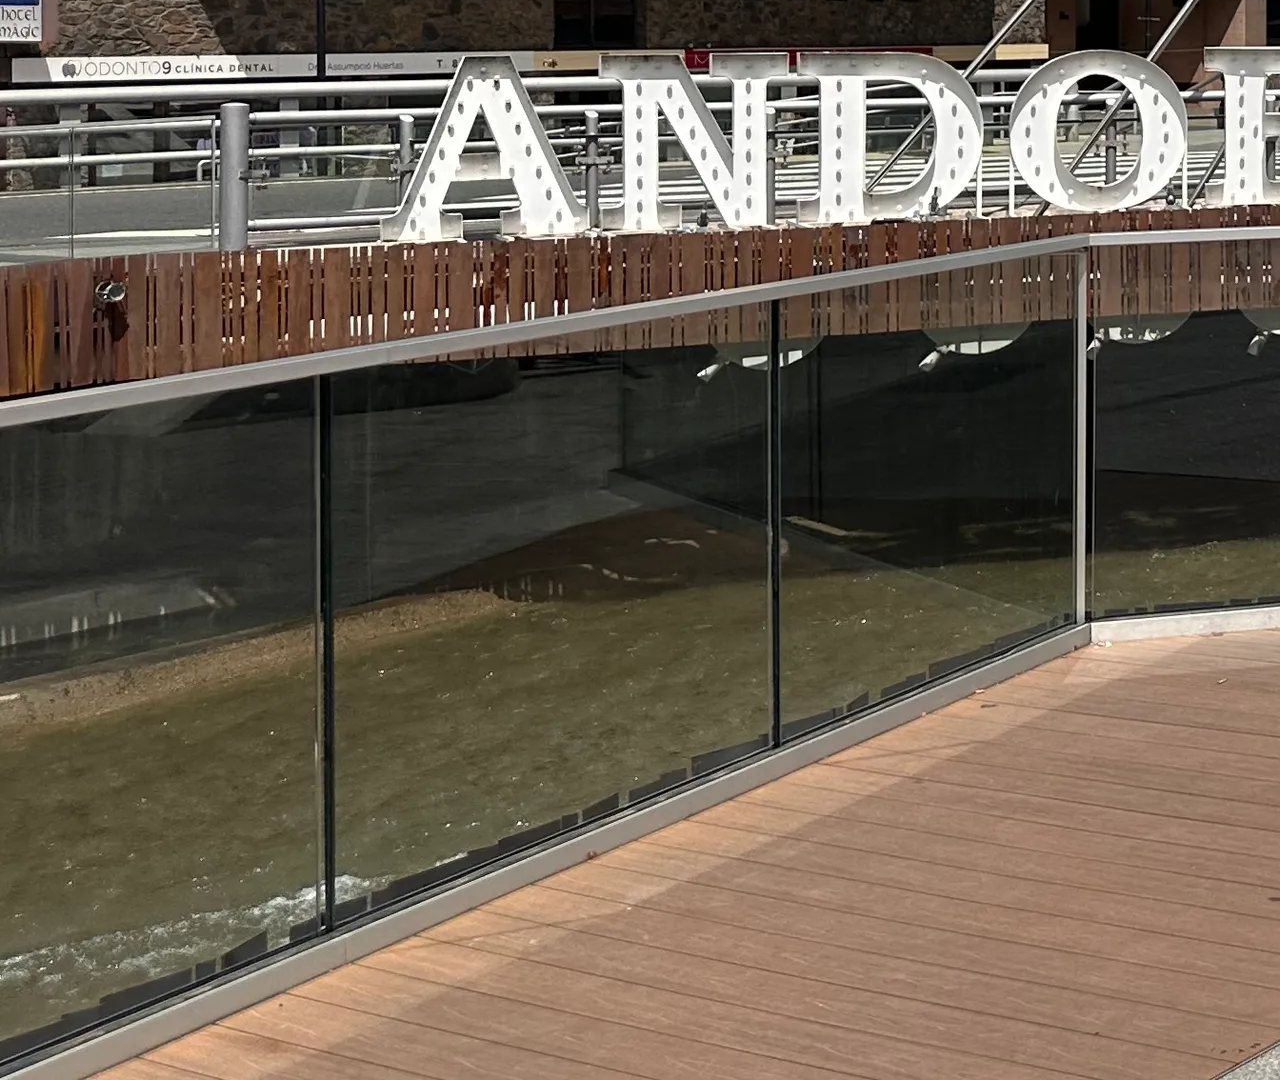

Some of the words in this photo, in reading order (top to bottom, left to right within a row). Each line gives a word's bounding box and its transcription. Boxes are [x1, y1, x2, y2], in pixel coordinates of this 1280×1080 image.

[84, 60, 171, 77] ODONTO9
[175, 61, 224, 75] CLÍNICA
[229, 63, 274, 73] DENTAL
[373, 60, 404, 71] Huertas
